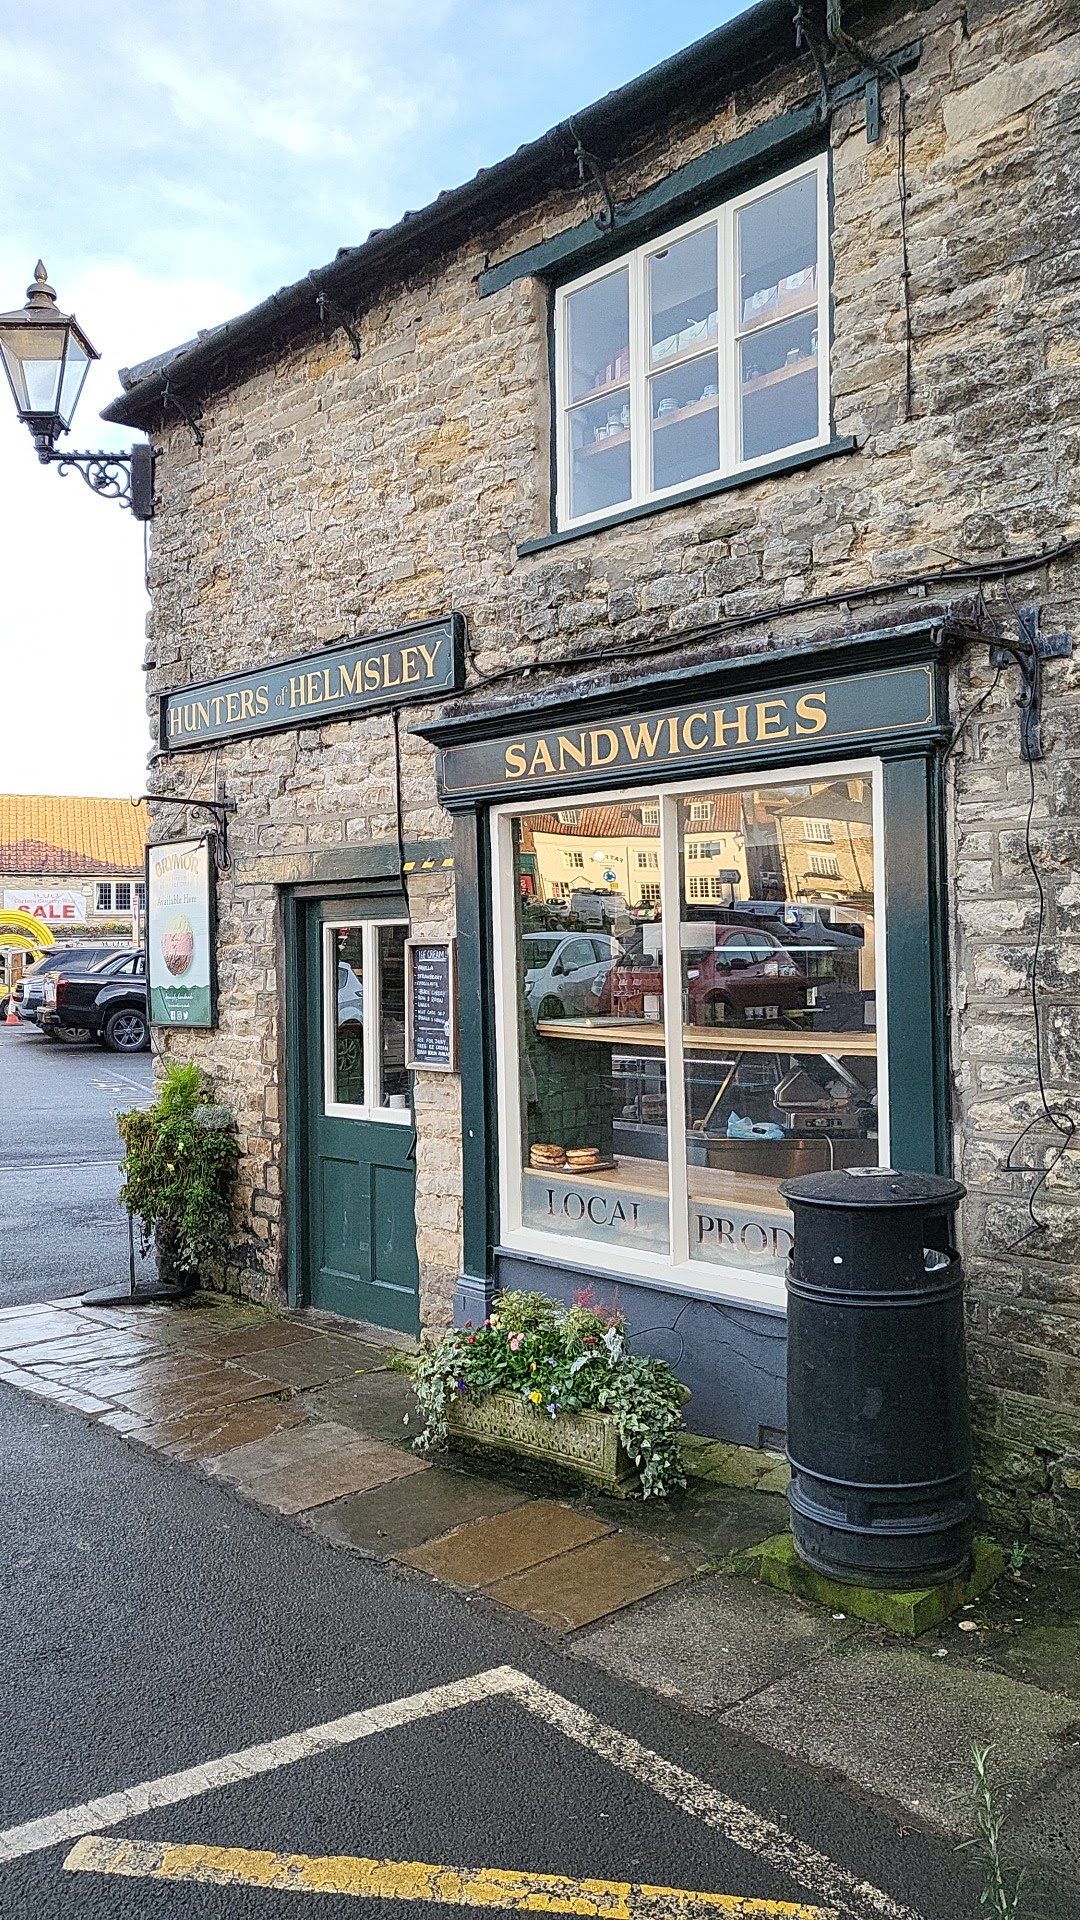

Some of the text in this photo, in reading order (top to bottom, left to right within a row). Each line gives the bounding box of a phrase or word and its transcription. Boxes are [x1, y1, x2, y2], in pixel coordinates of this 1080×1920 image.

[168, 640, 443, 737] HUNTERS of HELMSLEY
[503, 691, 829, 780] SANDWICHES
[17, 905, 76, 919] SALE
[183, 893, 197, 904] Here
